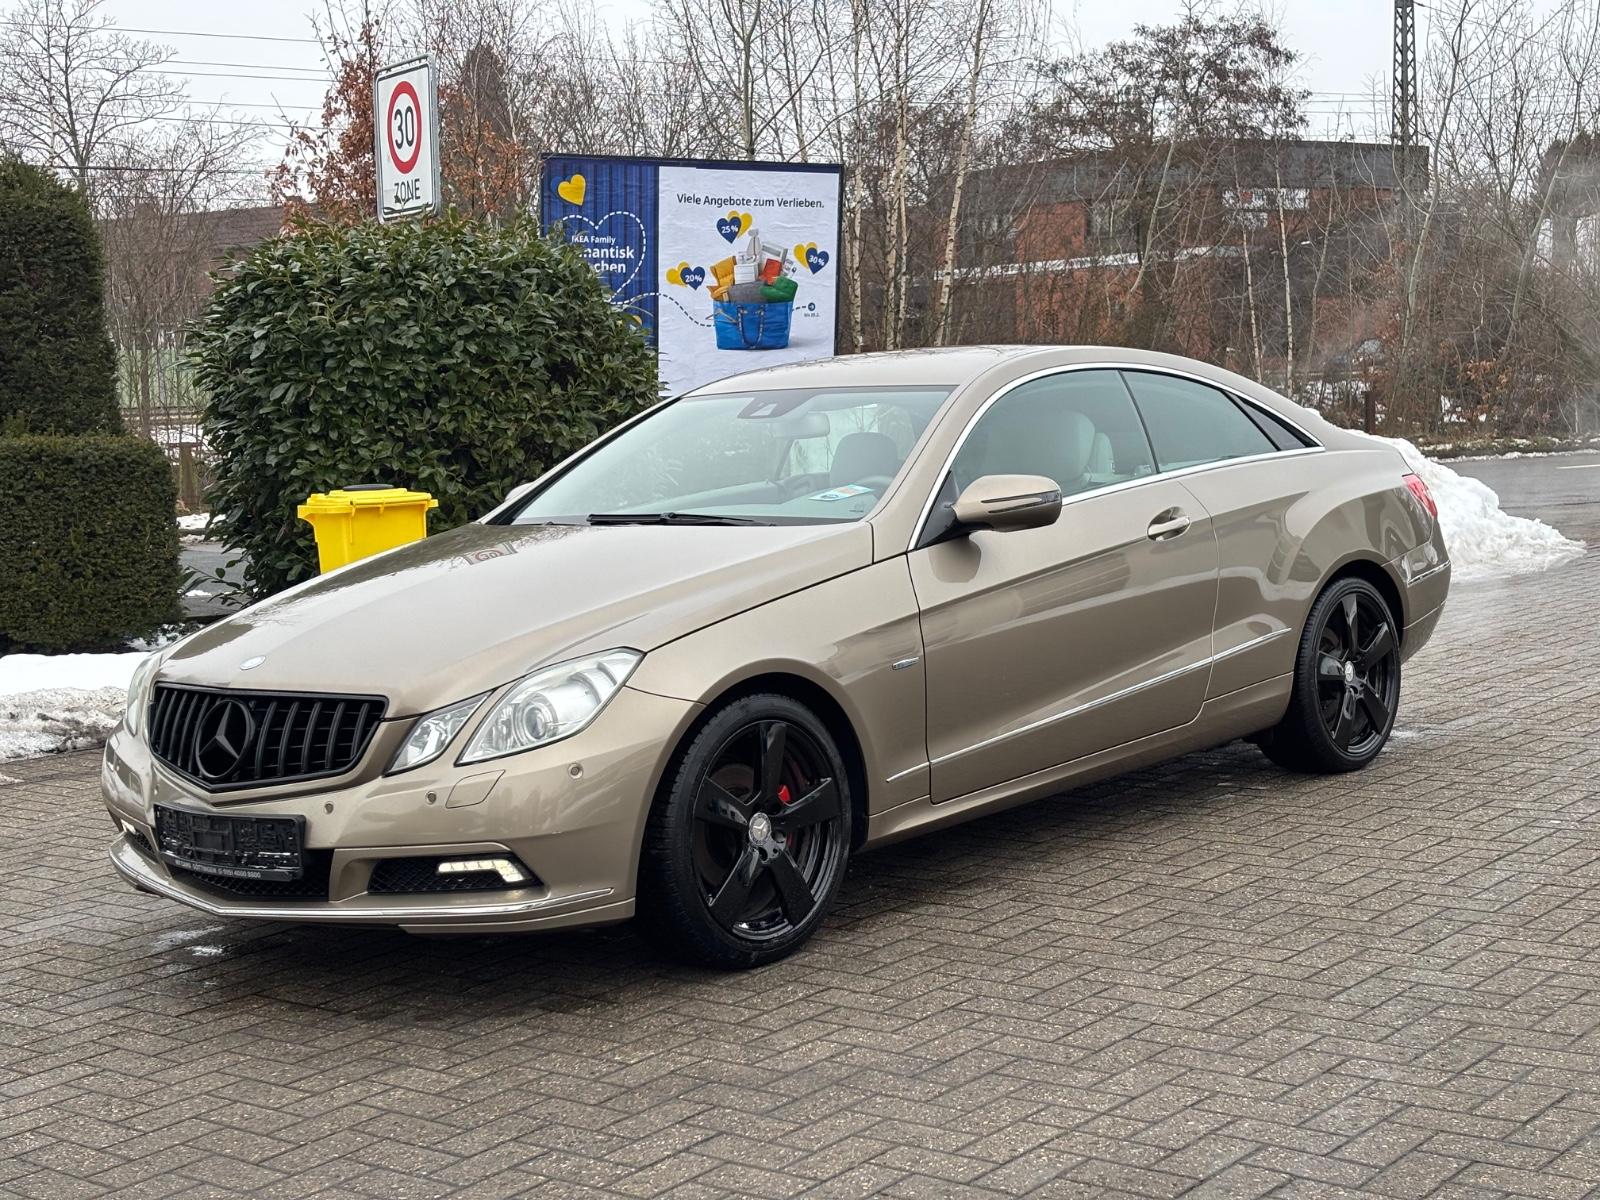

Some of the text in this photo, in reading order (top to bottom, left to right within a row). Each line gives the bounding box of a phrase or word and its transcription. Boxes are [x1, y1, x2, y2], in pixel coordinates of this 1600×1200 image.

[393, 105, 415, 149] 30
[394, 178, 421, 203] ZONE
[676, 193, 825, 209] Viele Angebote zum Verlieben.
[571, 235, 616, 246] IKEA Family
[594, 260, 626, 273] chen
